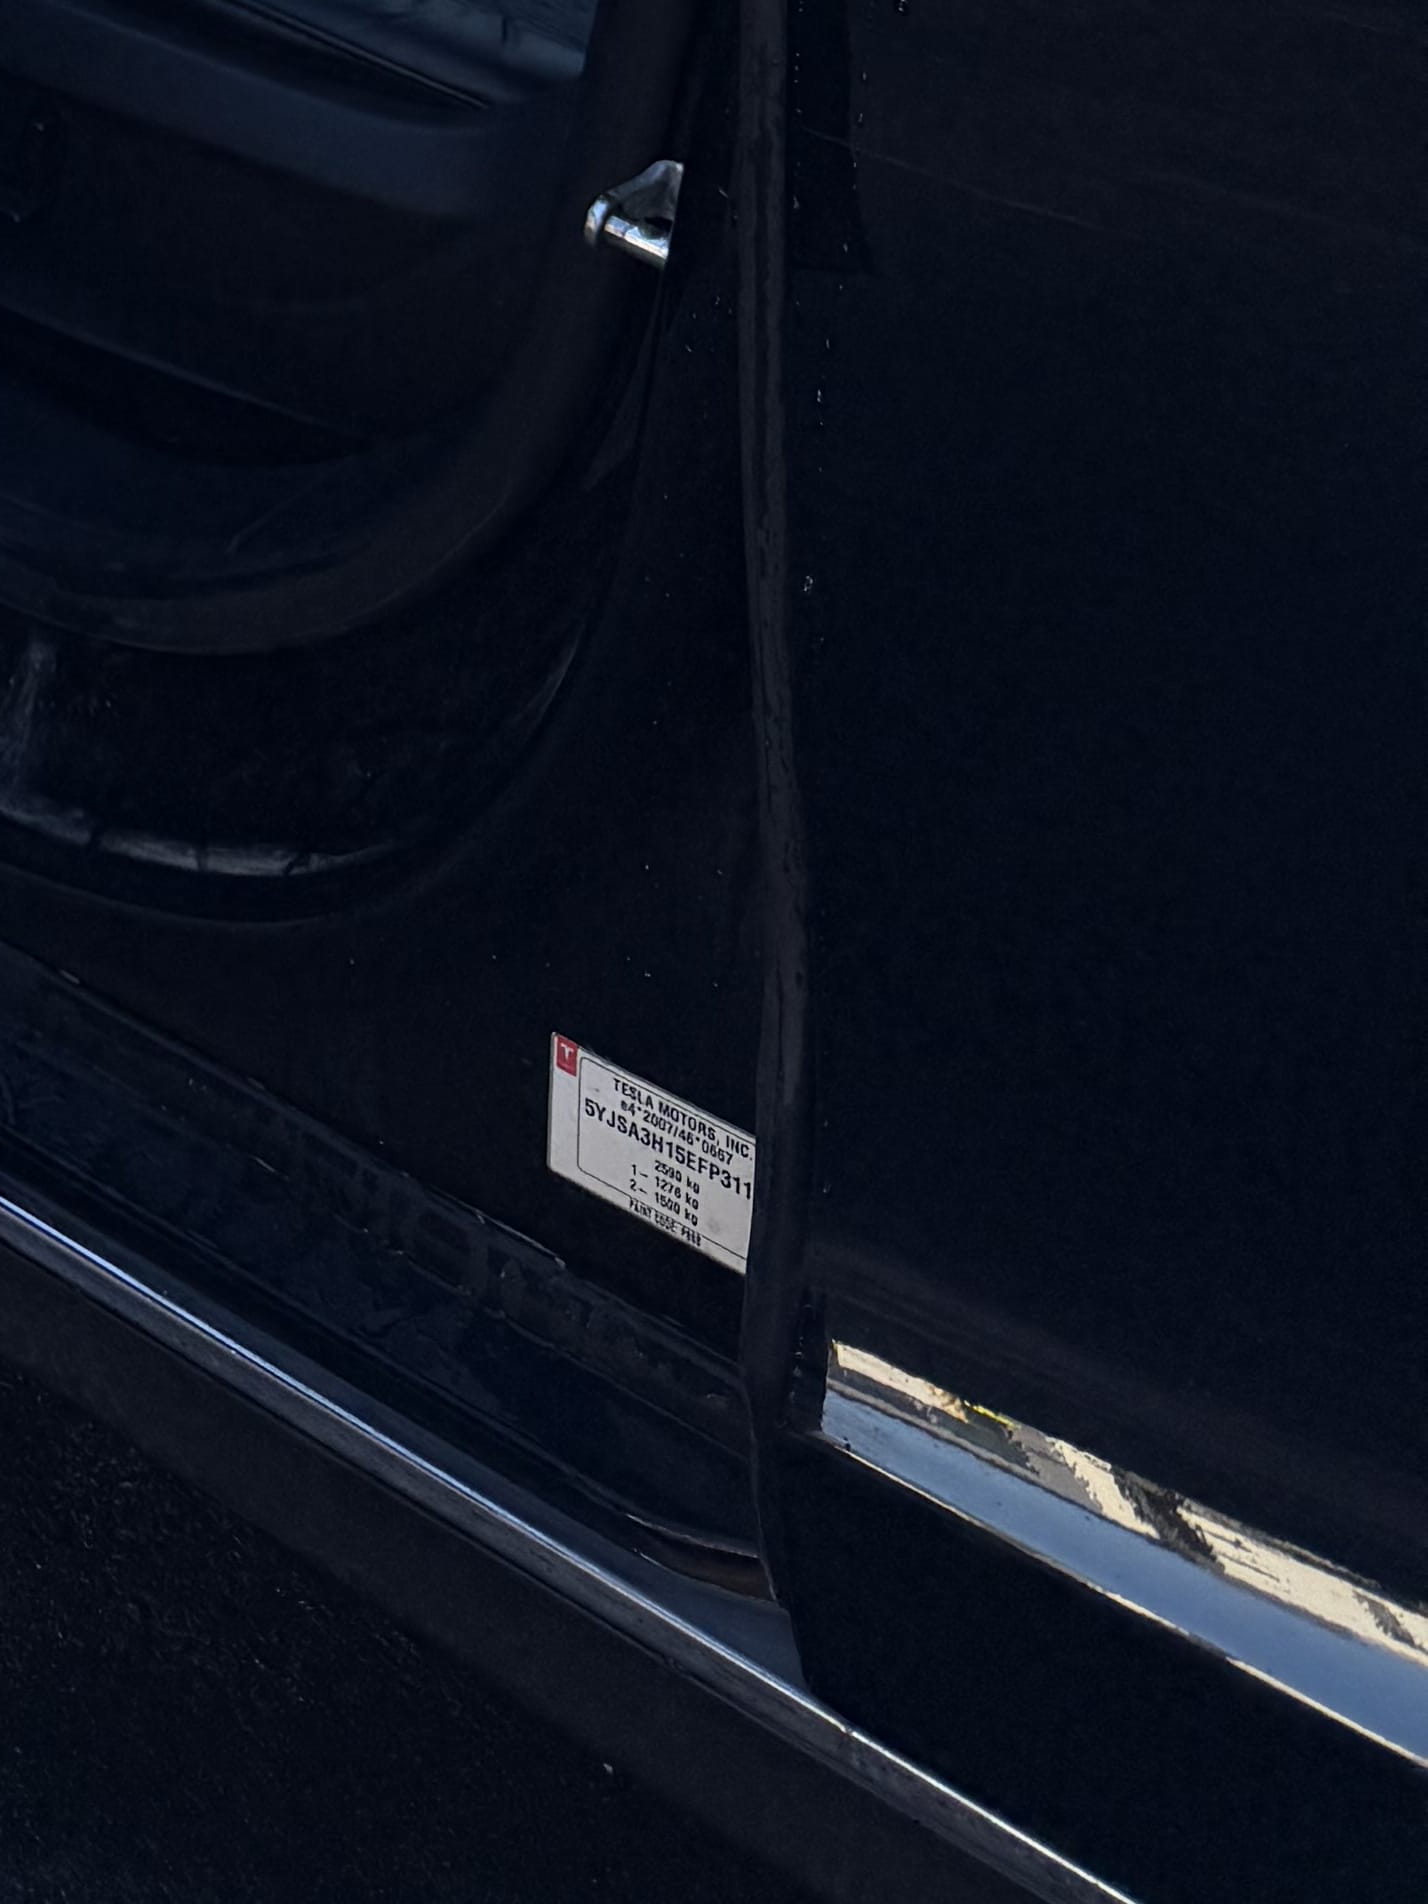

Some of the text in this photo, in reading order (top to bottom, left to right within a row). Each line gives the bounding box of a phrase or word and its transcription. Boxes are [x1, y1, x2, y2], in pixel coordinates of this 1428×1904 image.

[613, 1078, 753, 1160] TESLA MOTORS, INC.
[686, 1176, 700, 1195] kg
[685, 1192, 699, 1211] kg
[684, 1208, 698, 1227] kg
